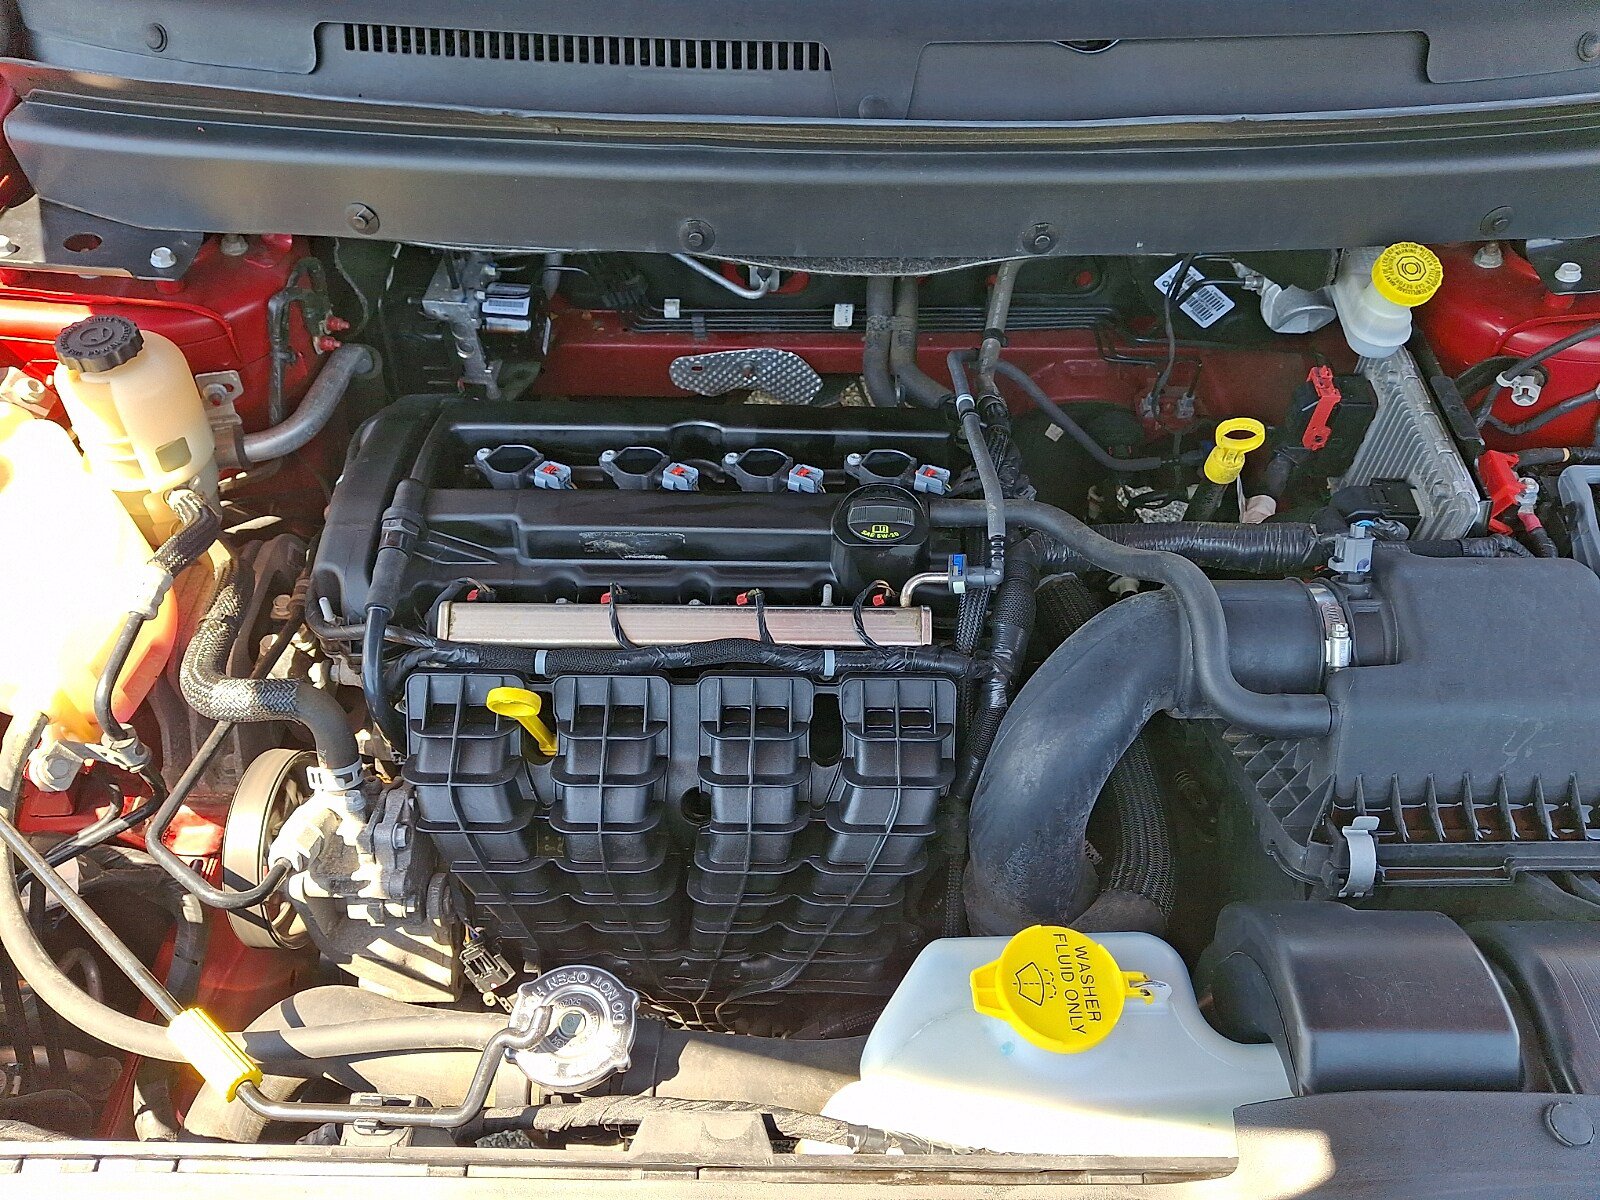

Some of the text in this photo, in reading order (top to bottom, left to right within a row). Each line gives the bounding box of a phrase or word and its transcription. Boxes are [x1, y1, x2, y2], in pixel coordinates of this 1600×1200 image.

[546, 971, 626, 1024] DO NOT OPEN
[1053, 933, 1087, 1035] FLUID ONLY
[1074, 945, 1102, 1022] WASHER
